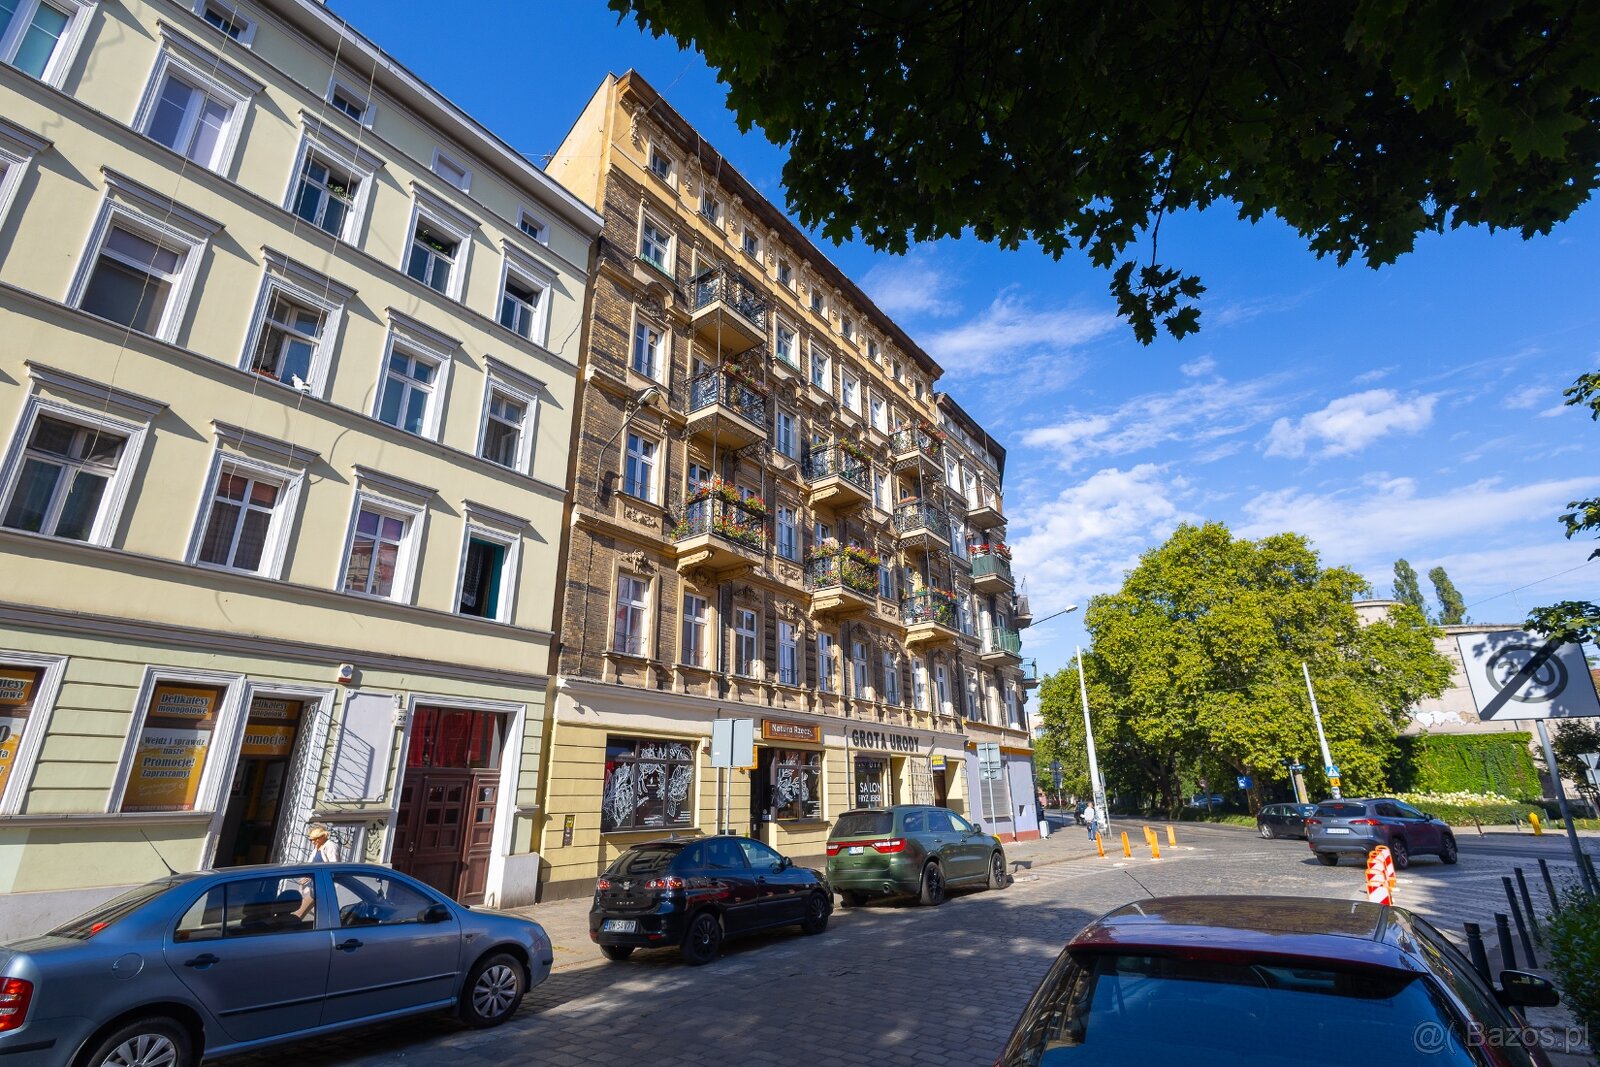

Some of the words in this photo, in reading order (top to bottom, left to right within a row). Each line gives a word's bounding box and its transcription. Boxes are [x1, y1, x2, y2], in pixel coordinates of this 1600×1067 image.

[160, 694, 209, 706] Delikatesy
[157, 705, 208, 714] monopolowe
[243, 735, 288, 745] romocje!
[852, 729, 887, 750] GROTA
[889, 733, 919, 752] URODY
[143, 757, 195, 768] Promocje!
